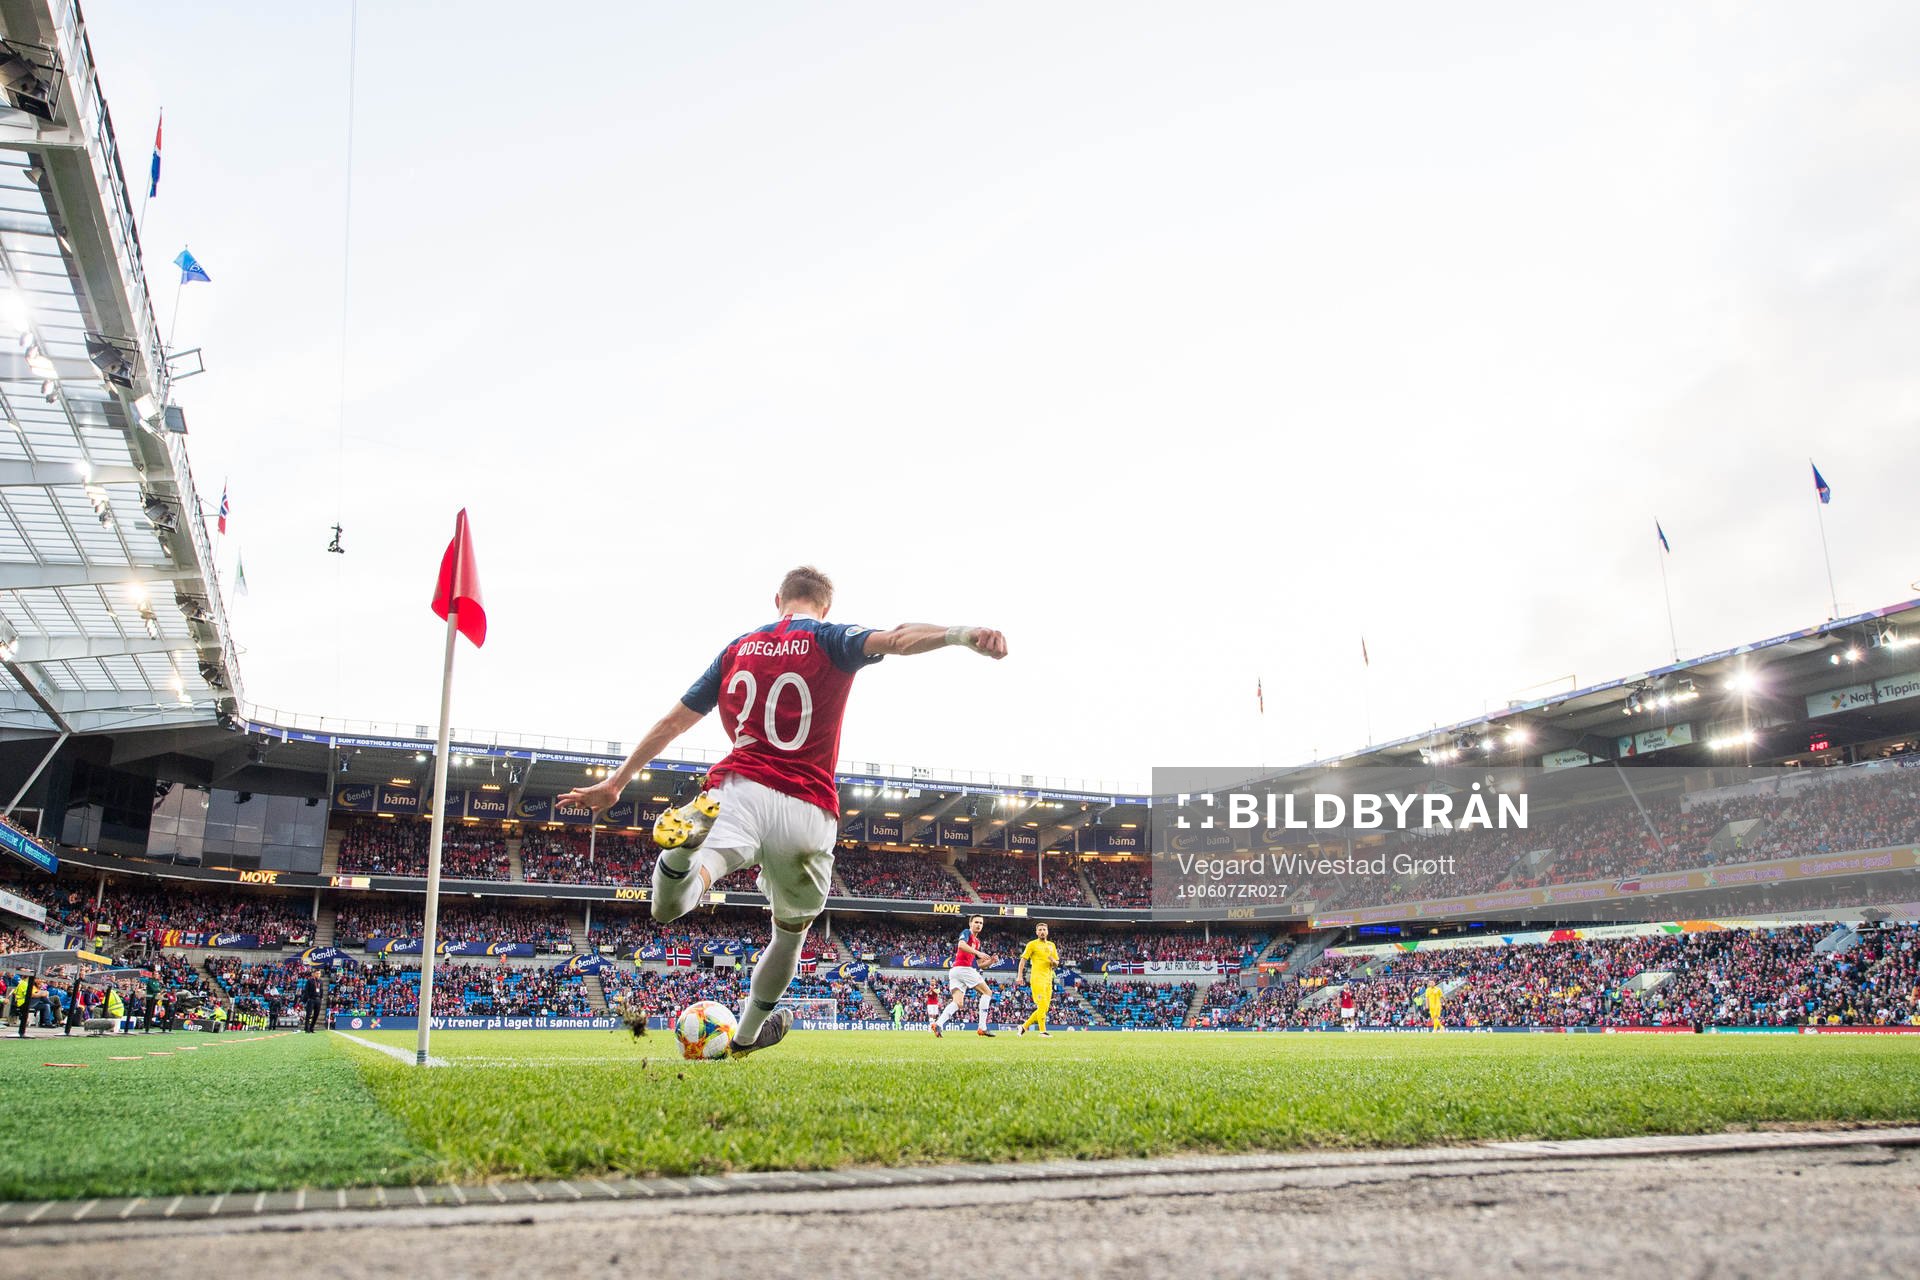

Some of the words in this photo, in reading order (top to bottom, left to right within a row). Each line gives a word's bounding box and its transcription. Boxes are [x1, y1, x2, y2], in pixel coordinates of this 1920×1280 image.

[738, 640, 809, 656] ØDEGAARD
[1883, 680, 1920, 697] Tippin
[727, 670, 813, 751] 20
[537, 753, 563, 761] OPPLEV
[384, 793, 416, 806] bama
[473, 799, 505, 812] bama
[524, 800, 548, 813] Bendit
[560, 805, 590, 817] bama
[643, 809, 660, 822] ba
[873, 825, 899, 837] bama
[944, 831, 969, 841] bama
[1012, 834, 1036, 845] bama
[1109, 836, 1136, 846] bama
[240, 871, 277, 885] MOVE
[615, 889, 648, 900] MOVE
[933, 903, 961, 914] MOVE
[1228, 908, 1255, 918] MOVE
[217, 934, 242, 946] Bendit
[312, 947, 337, 961] Bendit
[495, 942, 517, 955] Bendit
[578, 955, 600, 968] Bendit
[1107, 962, 1122, 973] Bend
[1165, 961, 1173, 971] ALT
[1175, 961, 1184, 971] FOR
[430, 1017, 441, 1030] Ny
[448, 1017, 486, 1028] trener
[488, 1016, 501, 1030] på
[504, 1017, 533, 1030] laget
[535, 1017, 547, 1028] til
[550, 1018, 589, 1029] sønnen
[592, 1017, 616, 1029] din?
[803, 1020, 816, 1030] Ny
[852, 1020, 863, 1031] på
[866, 1020, 890, 1031] laget
[946, 1020, 965, 1031] din?
